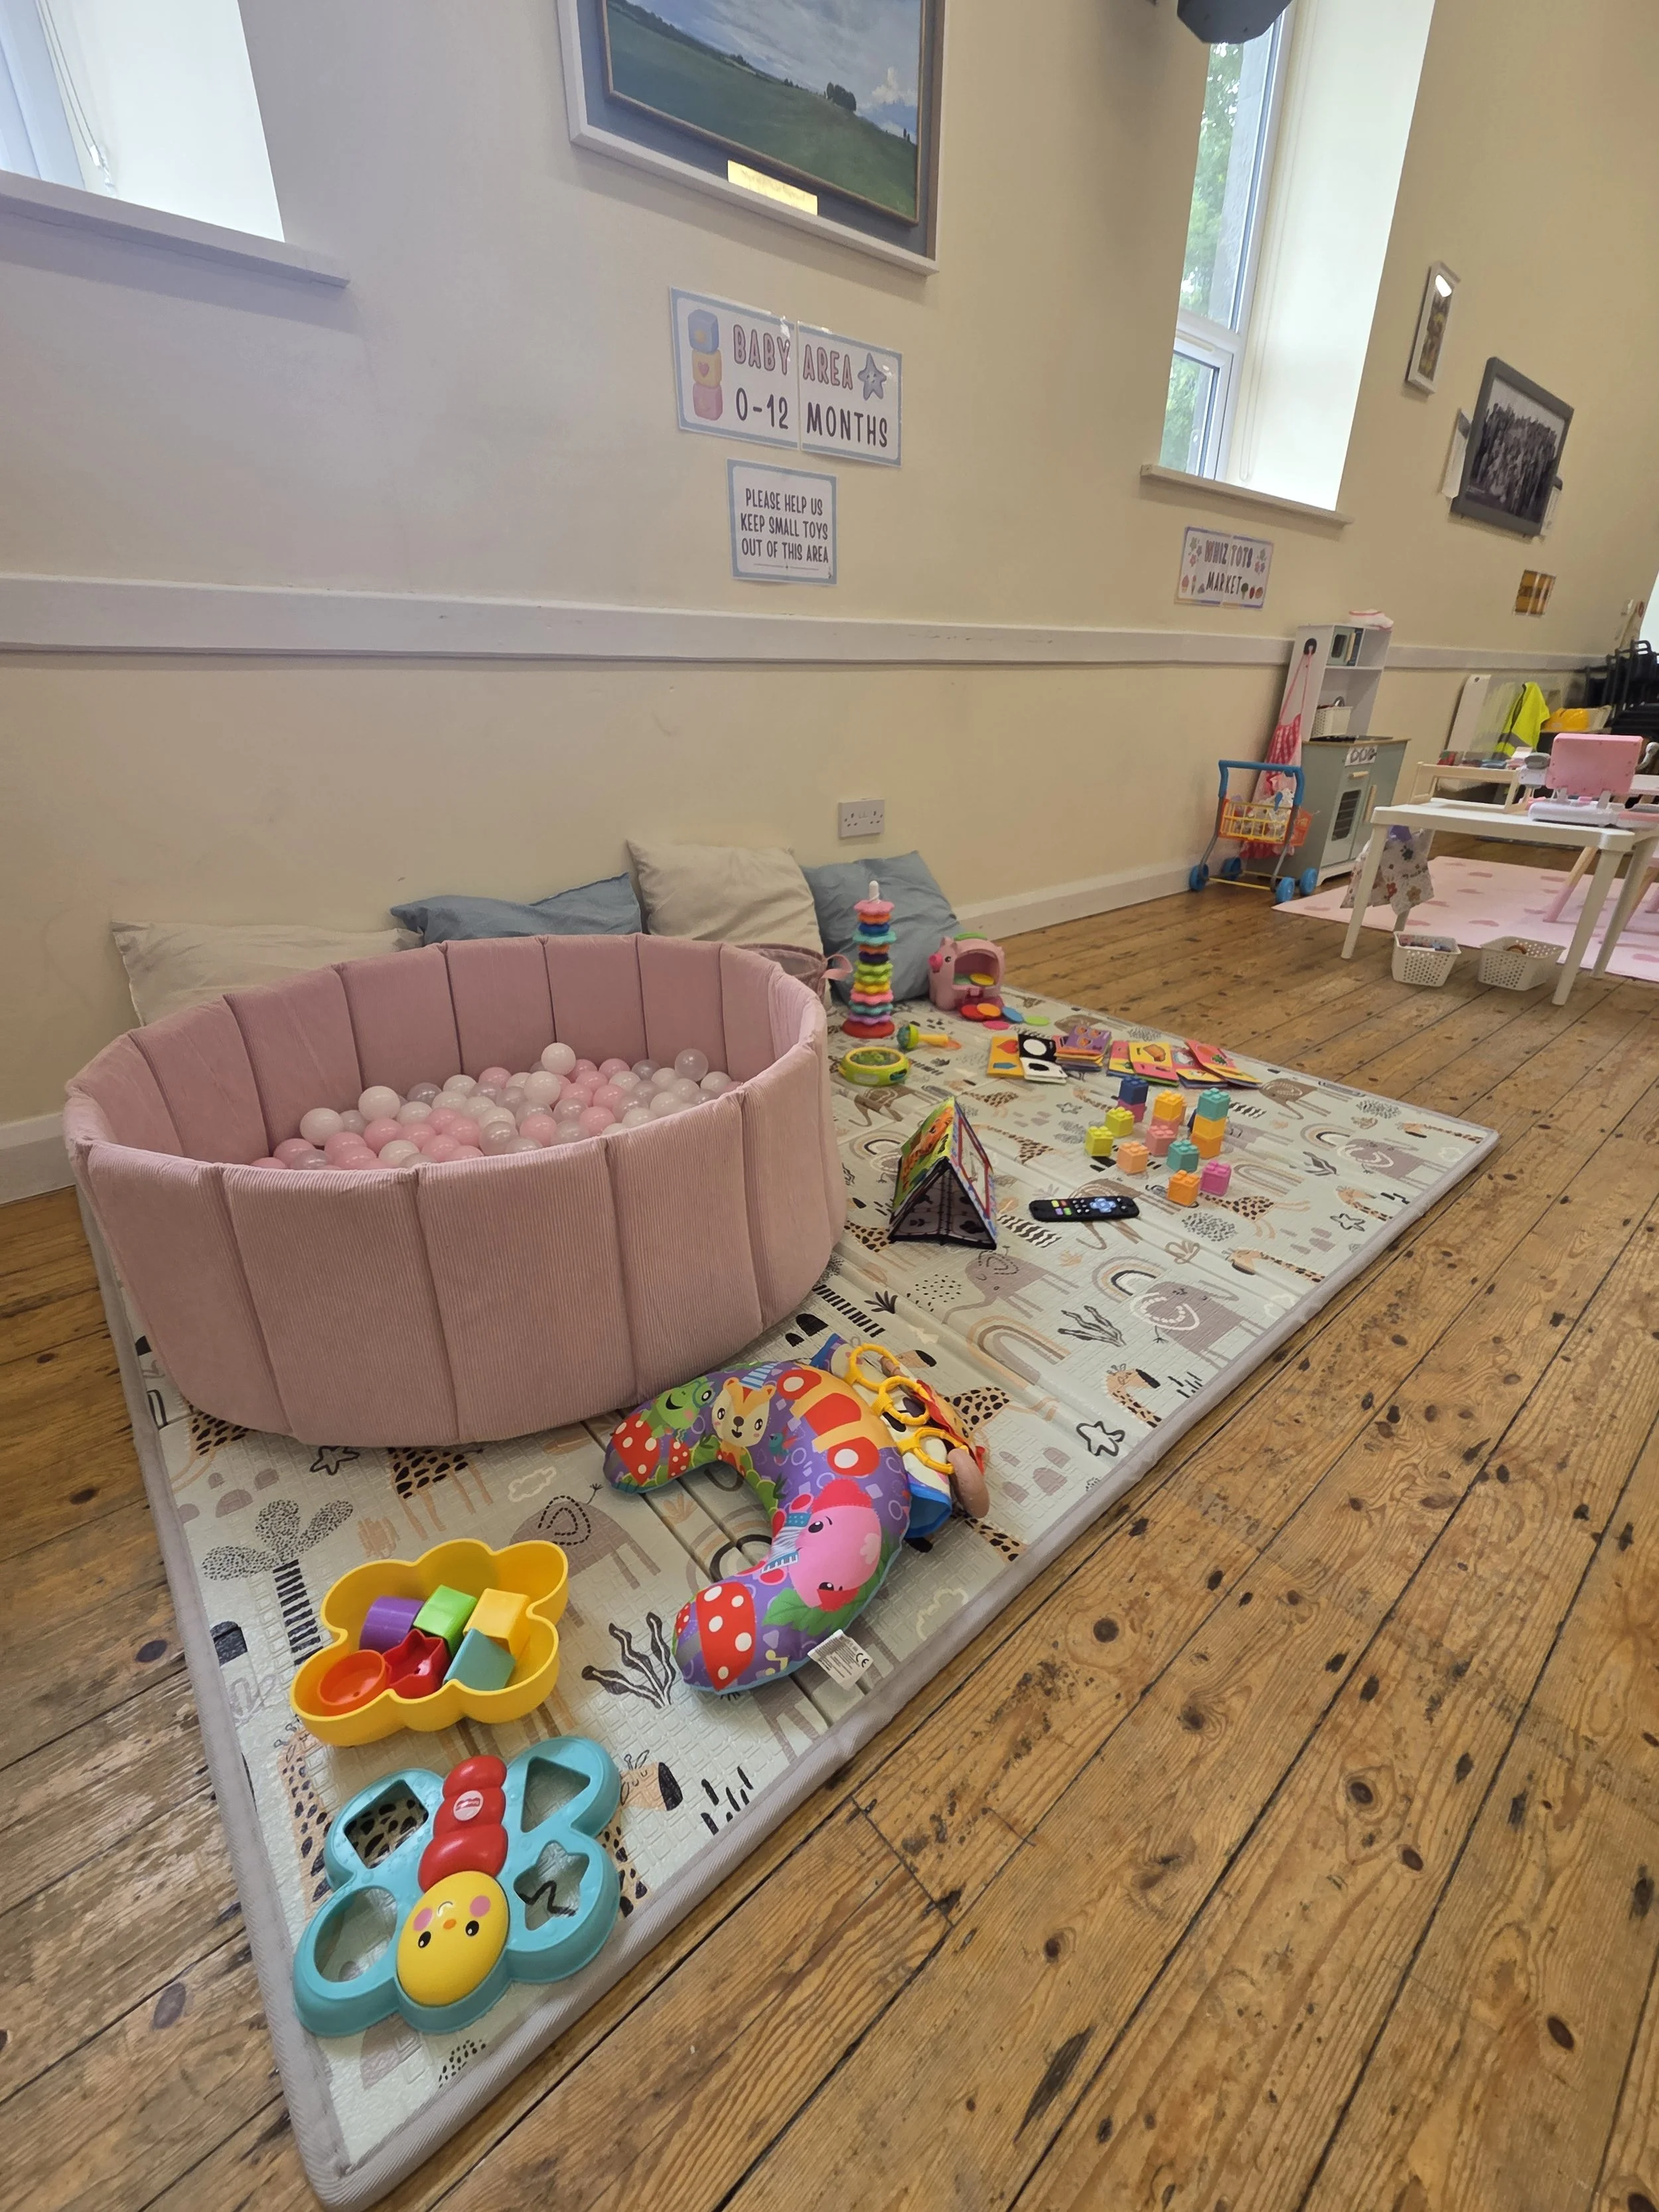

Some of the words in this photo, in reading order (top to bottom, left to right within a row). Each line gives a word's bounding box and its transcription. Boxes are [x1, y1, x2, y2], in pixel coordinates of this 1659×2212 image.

[733, 324, 791, 376] BABY
[802, 344, 853, 390] AREA
[735, 387, 789, 430] 0-12
[806, 402, 888, 448] MONTHS
[745, 488, 781, 511] PLEASE
[784, 494, 807, 514] HELP
[811, 498, 824, 516] US
[741, 512, 765, 532] KEEP
[768, 516, 800, 538] SMALL
[802, 520, 828, 540] TOYS
[741, 538, 762, 557] OUT
[766, 540, 778, 558] OF
[782, 542, 803, 561] THIS
[806, 544, 829, 563] AREA
[1206, 571, 1243, 595] MARKET
